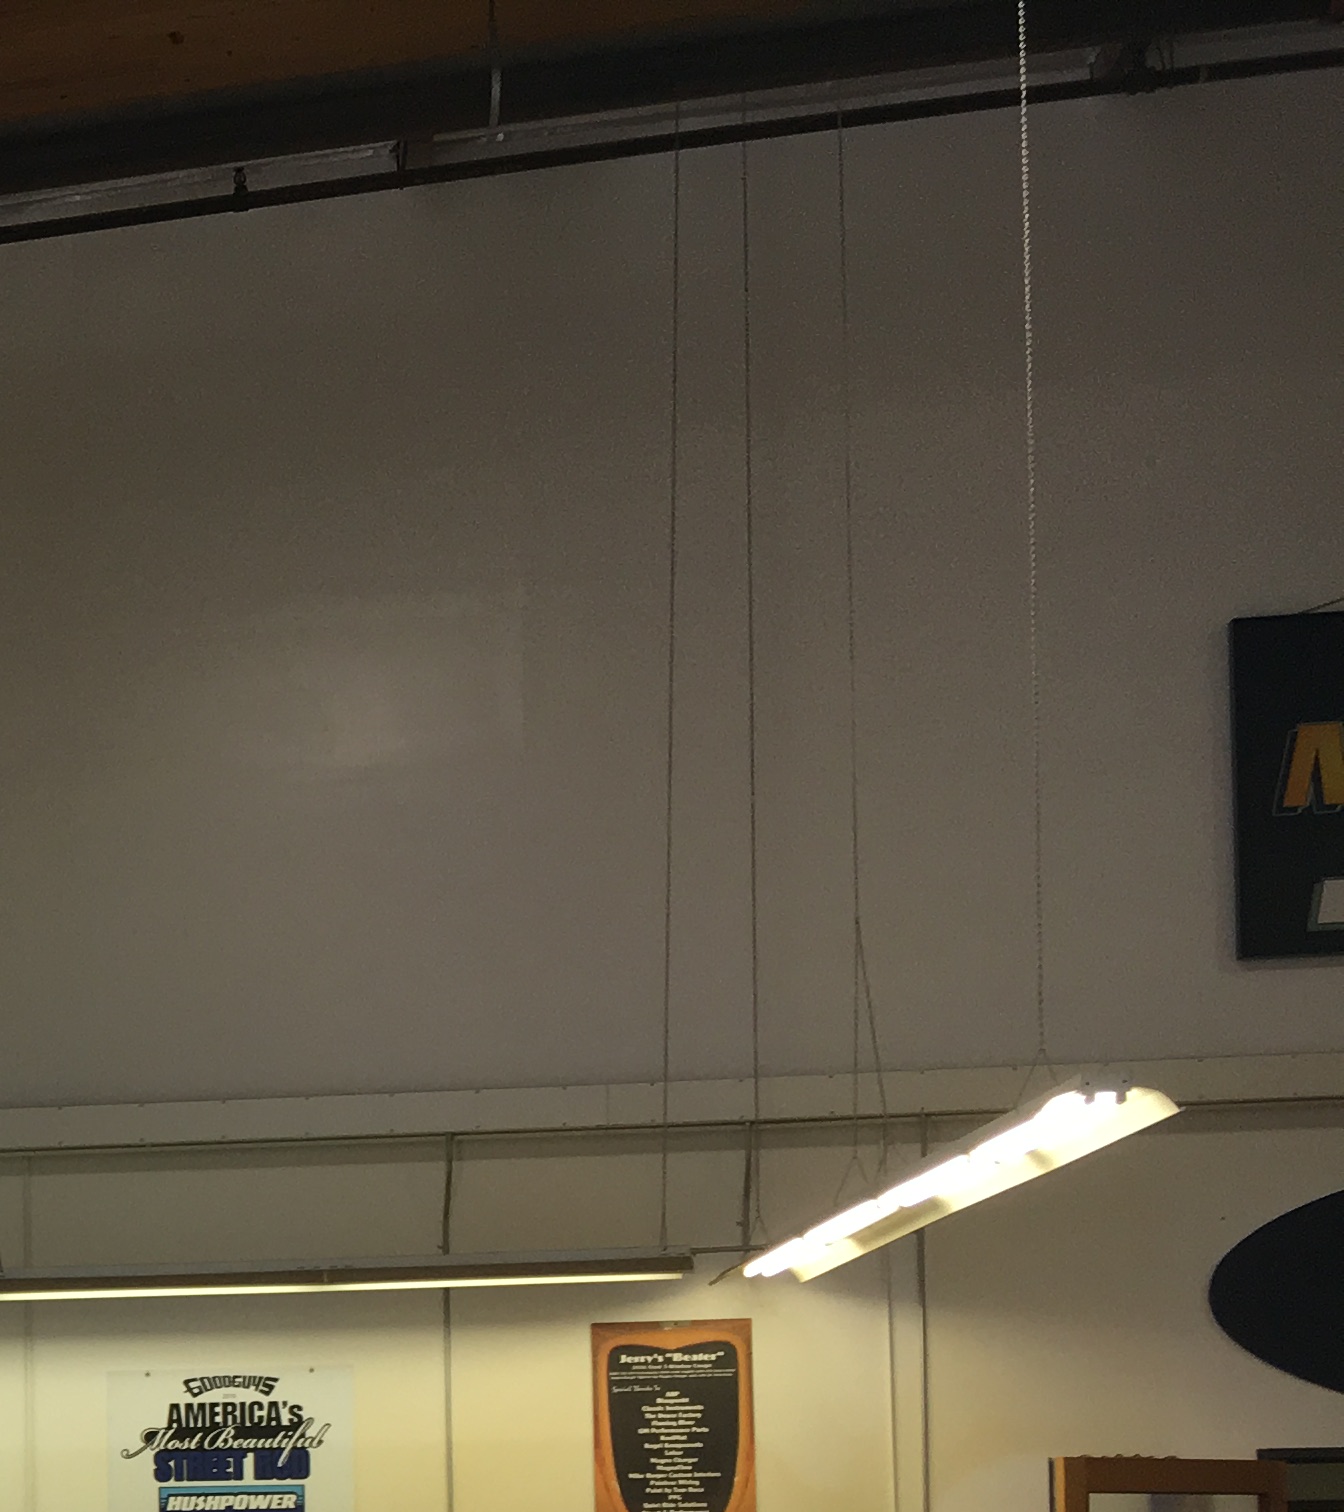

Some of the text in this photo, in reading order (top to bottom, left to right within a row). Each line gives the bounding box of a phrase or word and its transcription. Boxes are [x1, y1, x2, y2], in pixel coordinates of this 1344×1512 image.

[120, 1416, 333, 1468] Most Beautiful
[153, 1450, 248, 1483] STREET
